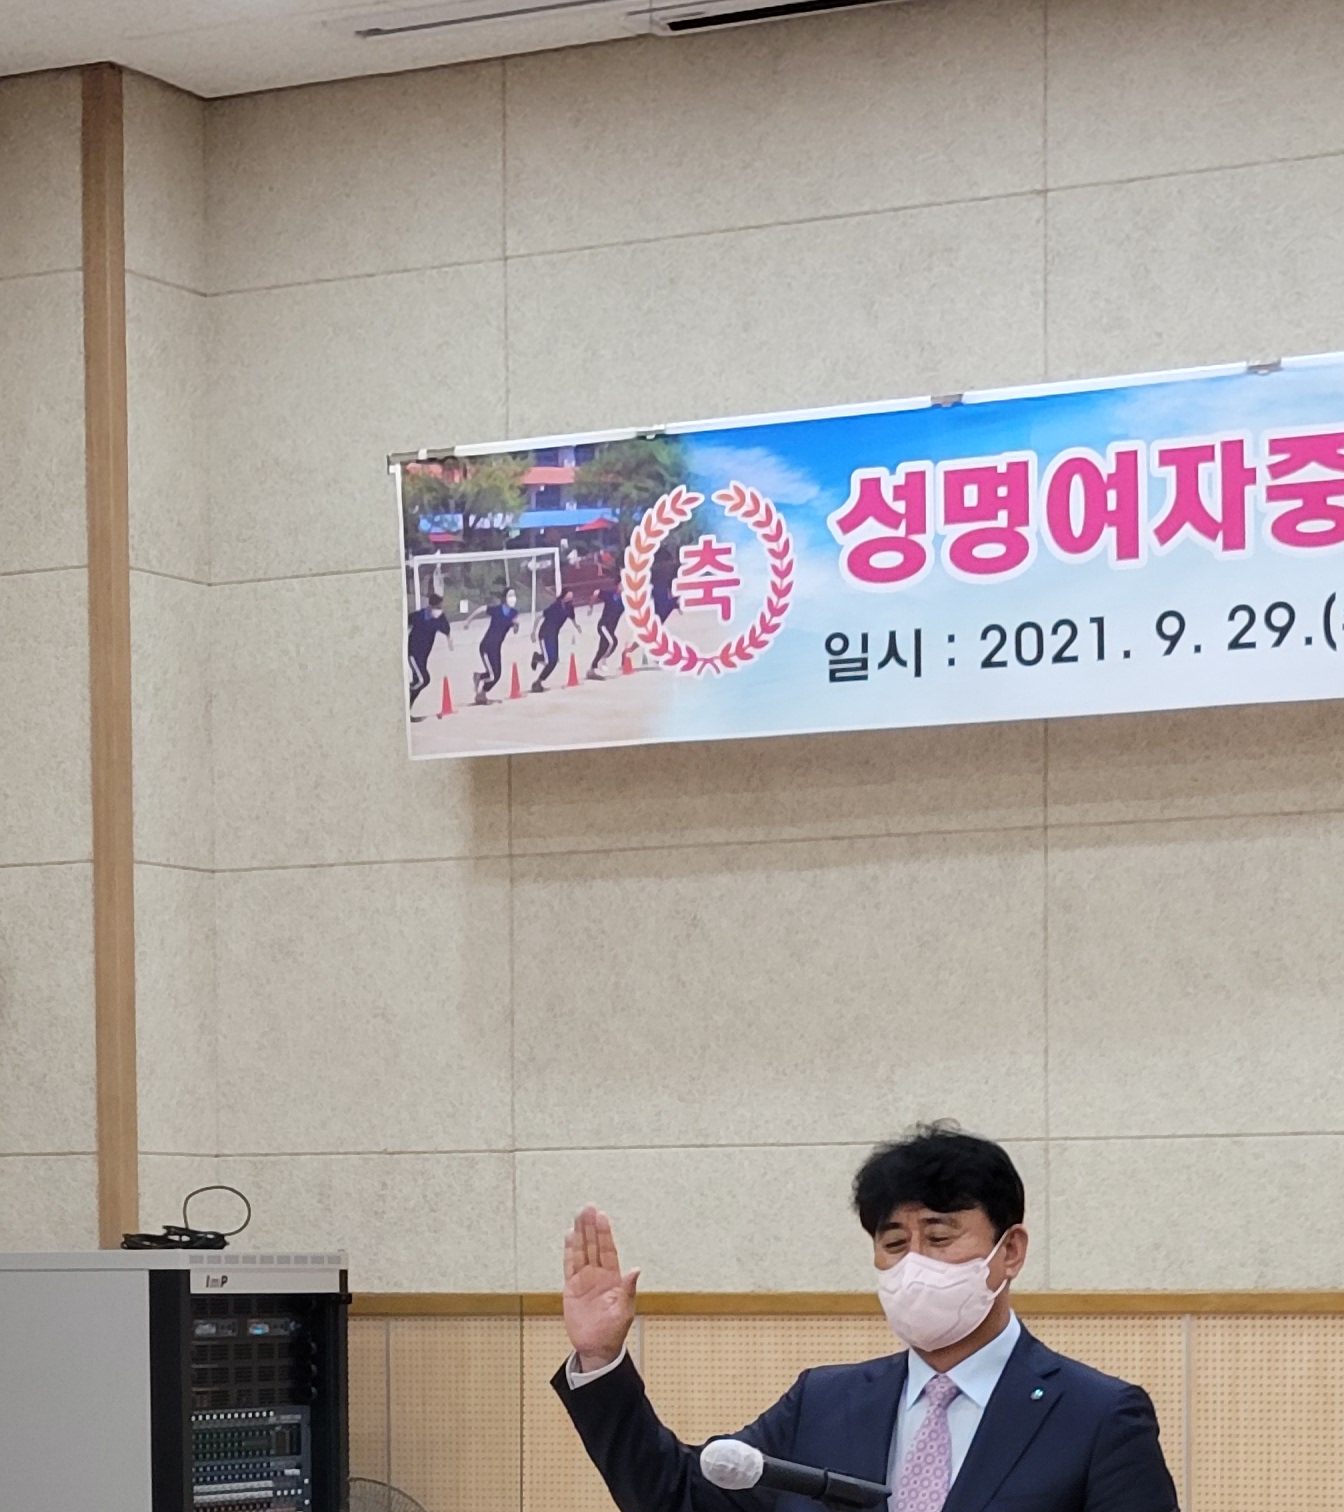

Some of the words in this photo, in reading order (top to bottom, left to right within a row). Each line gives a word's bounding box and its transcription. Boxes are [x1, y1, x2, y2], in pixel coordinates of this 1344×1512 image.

[676, 539, 741, 622] 축
[824, 628, 923, 683] 일시
[980, 616, 1132, 669] 2021.
[1155, 609, 1202, 656] 9.
